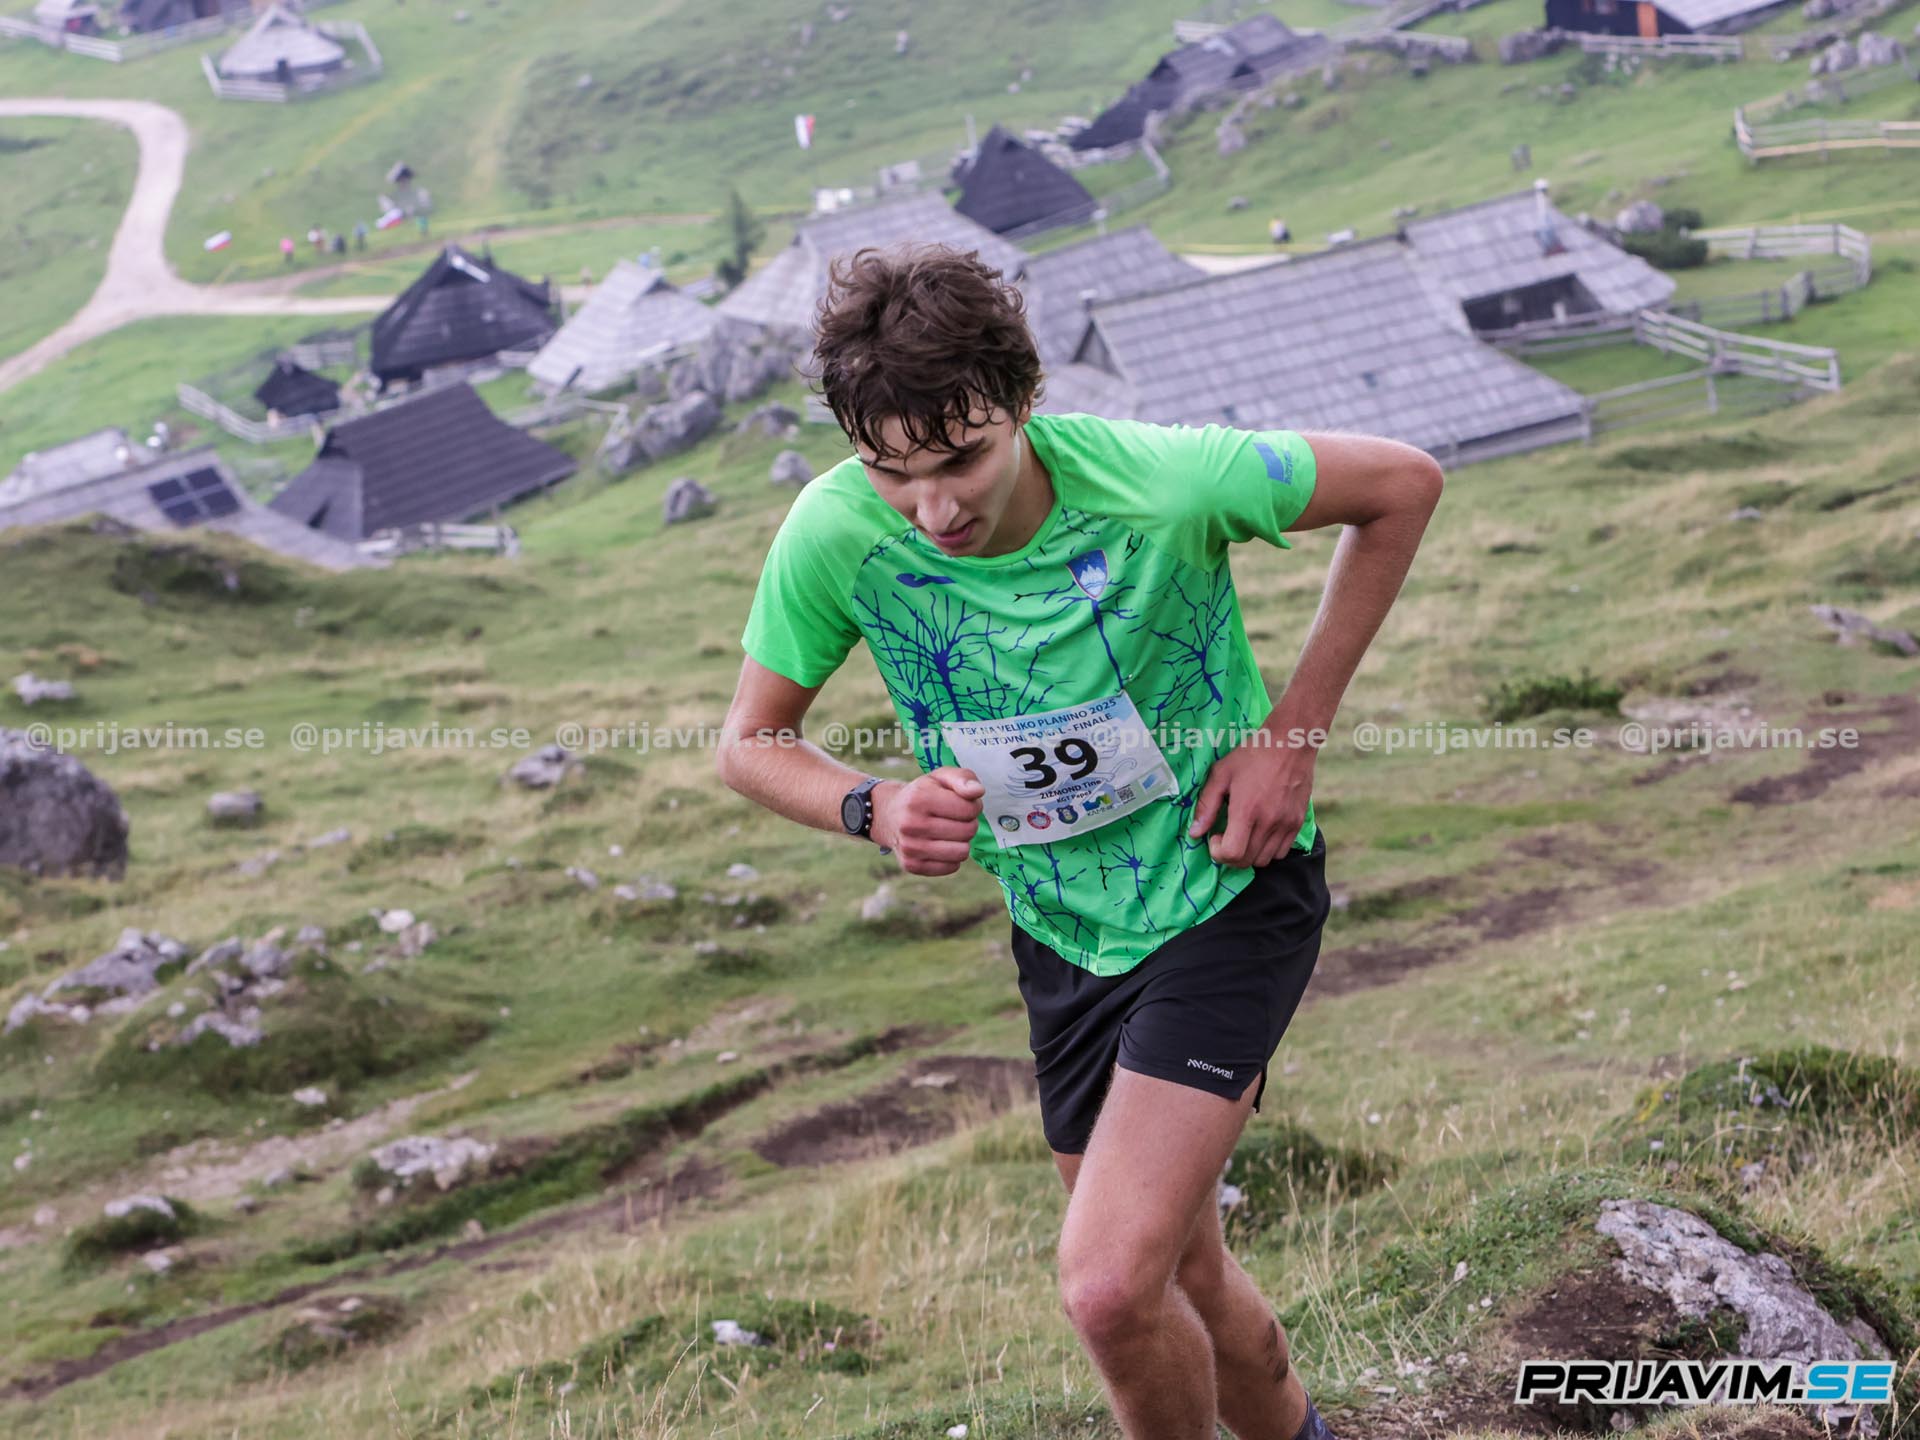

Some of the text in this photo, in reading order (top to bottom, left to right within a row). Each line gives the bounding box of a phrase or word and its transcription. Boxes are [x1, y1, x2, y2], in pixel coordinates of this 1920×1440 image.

[997, 720, 1036, 733] VELIKO
[1037, 710, 1088, 726] PLANINO
[1089, 698, 1117, 715] 2025
[1072, 712, 1113, 732] FINALE
[1009, 738, 1099, 790] 39
